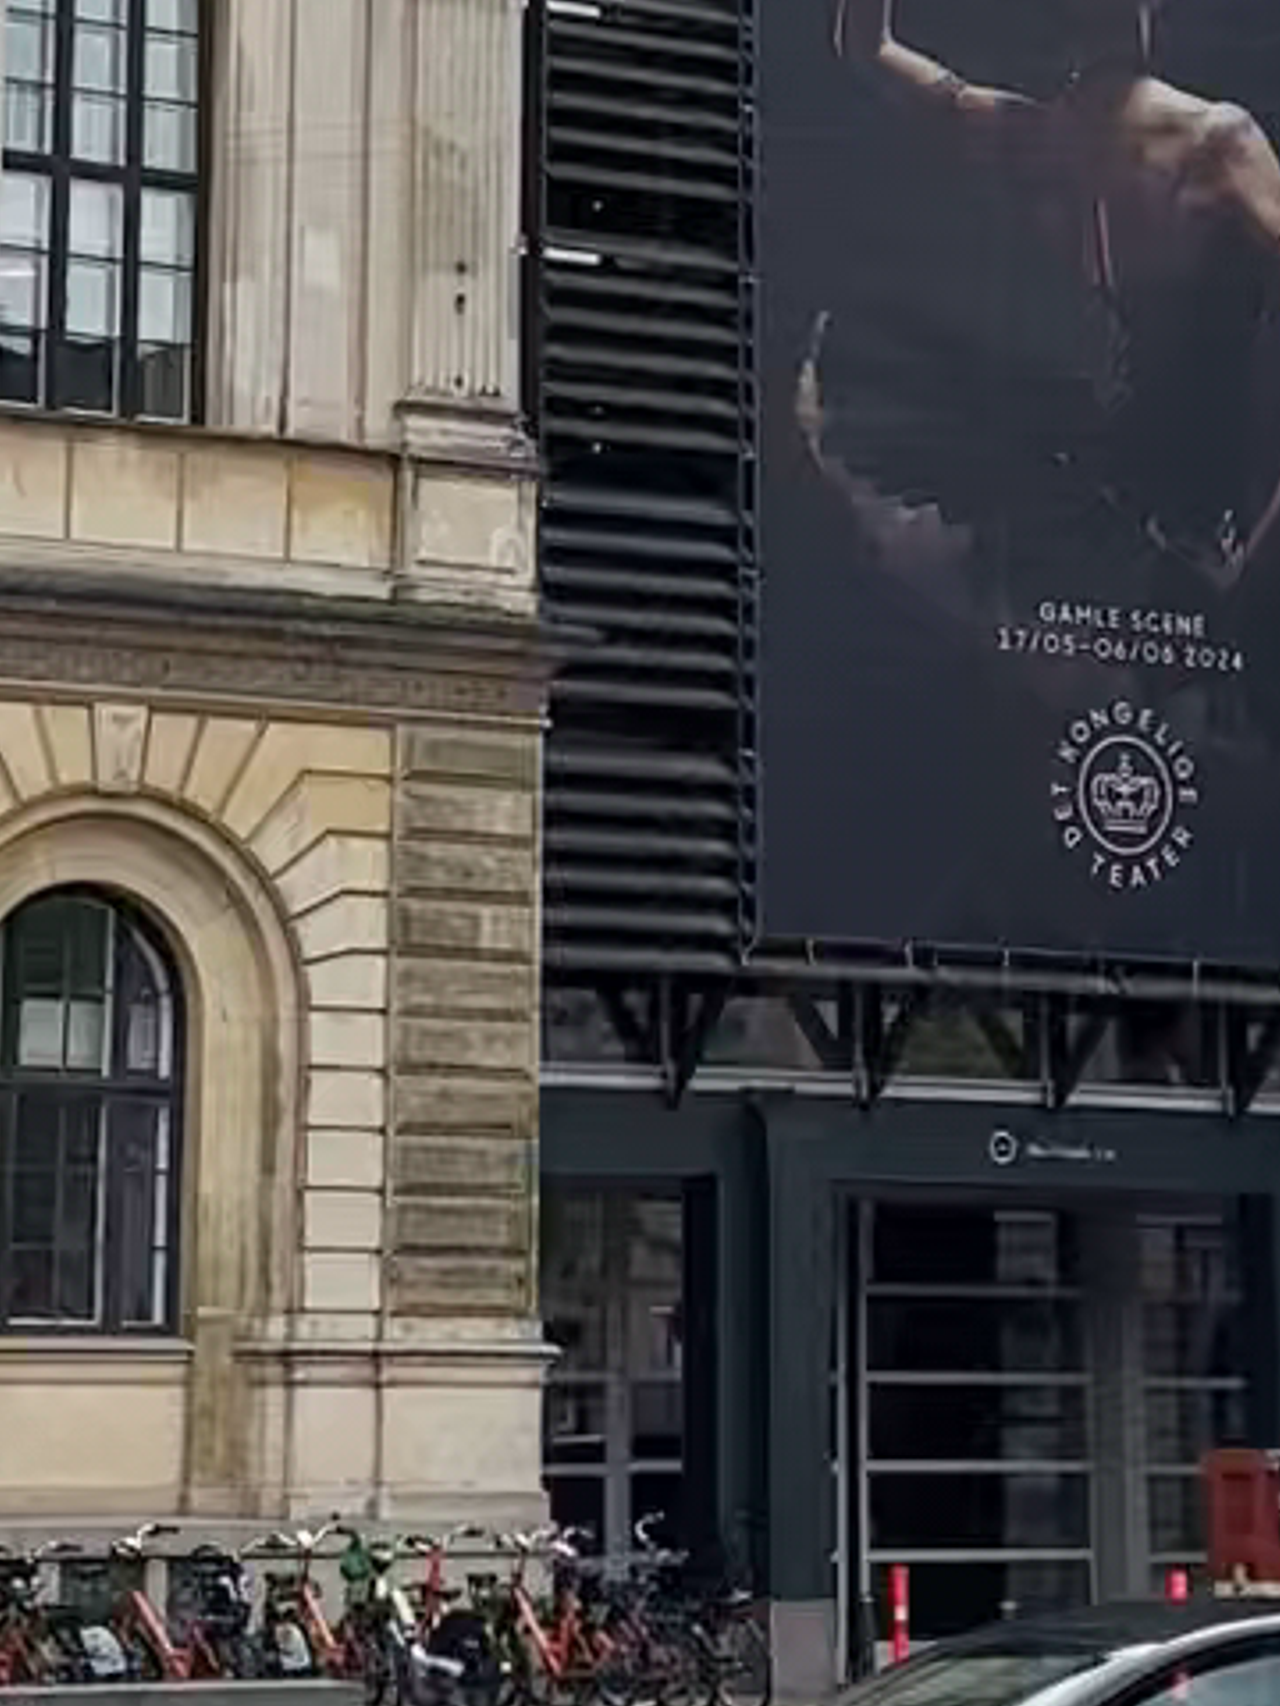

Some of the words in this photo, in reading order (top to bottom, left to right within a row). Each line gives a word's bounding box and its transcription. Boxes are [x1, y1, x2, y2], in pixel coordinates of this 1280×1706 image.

[1039, 601, 1120, 629] GAMLE
[1130, 608, 1205, 637] SCENE
[1184, 646, 1243, 671] 2024
[1091, 825, 1193, 888] TEATER
